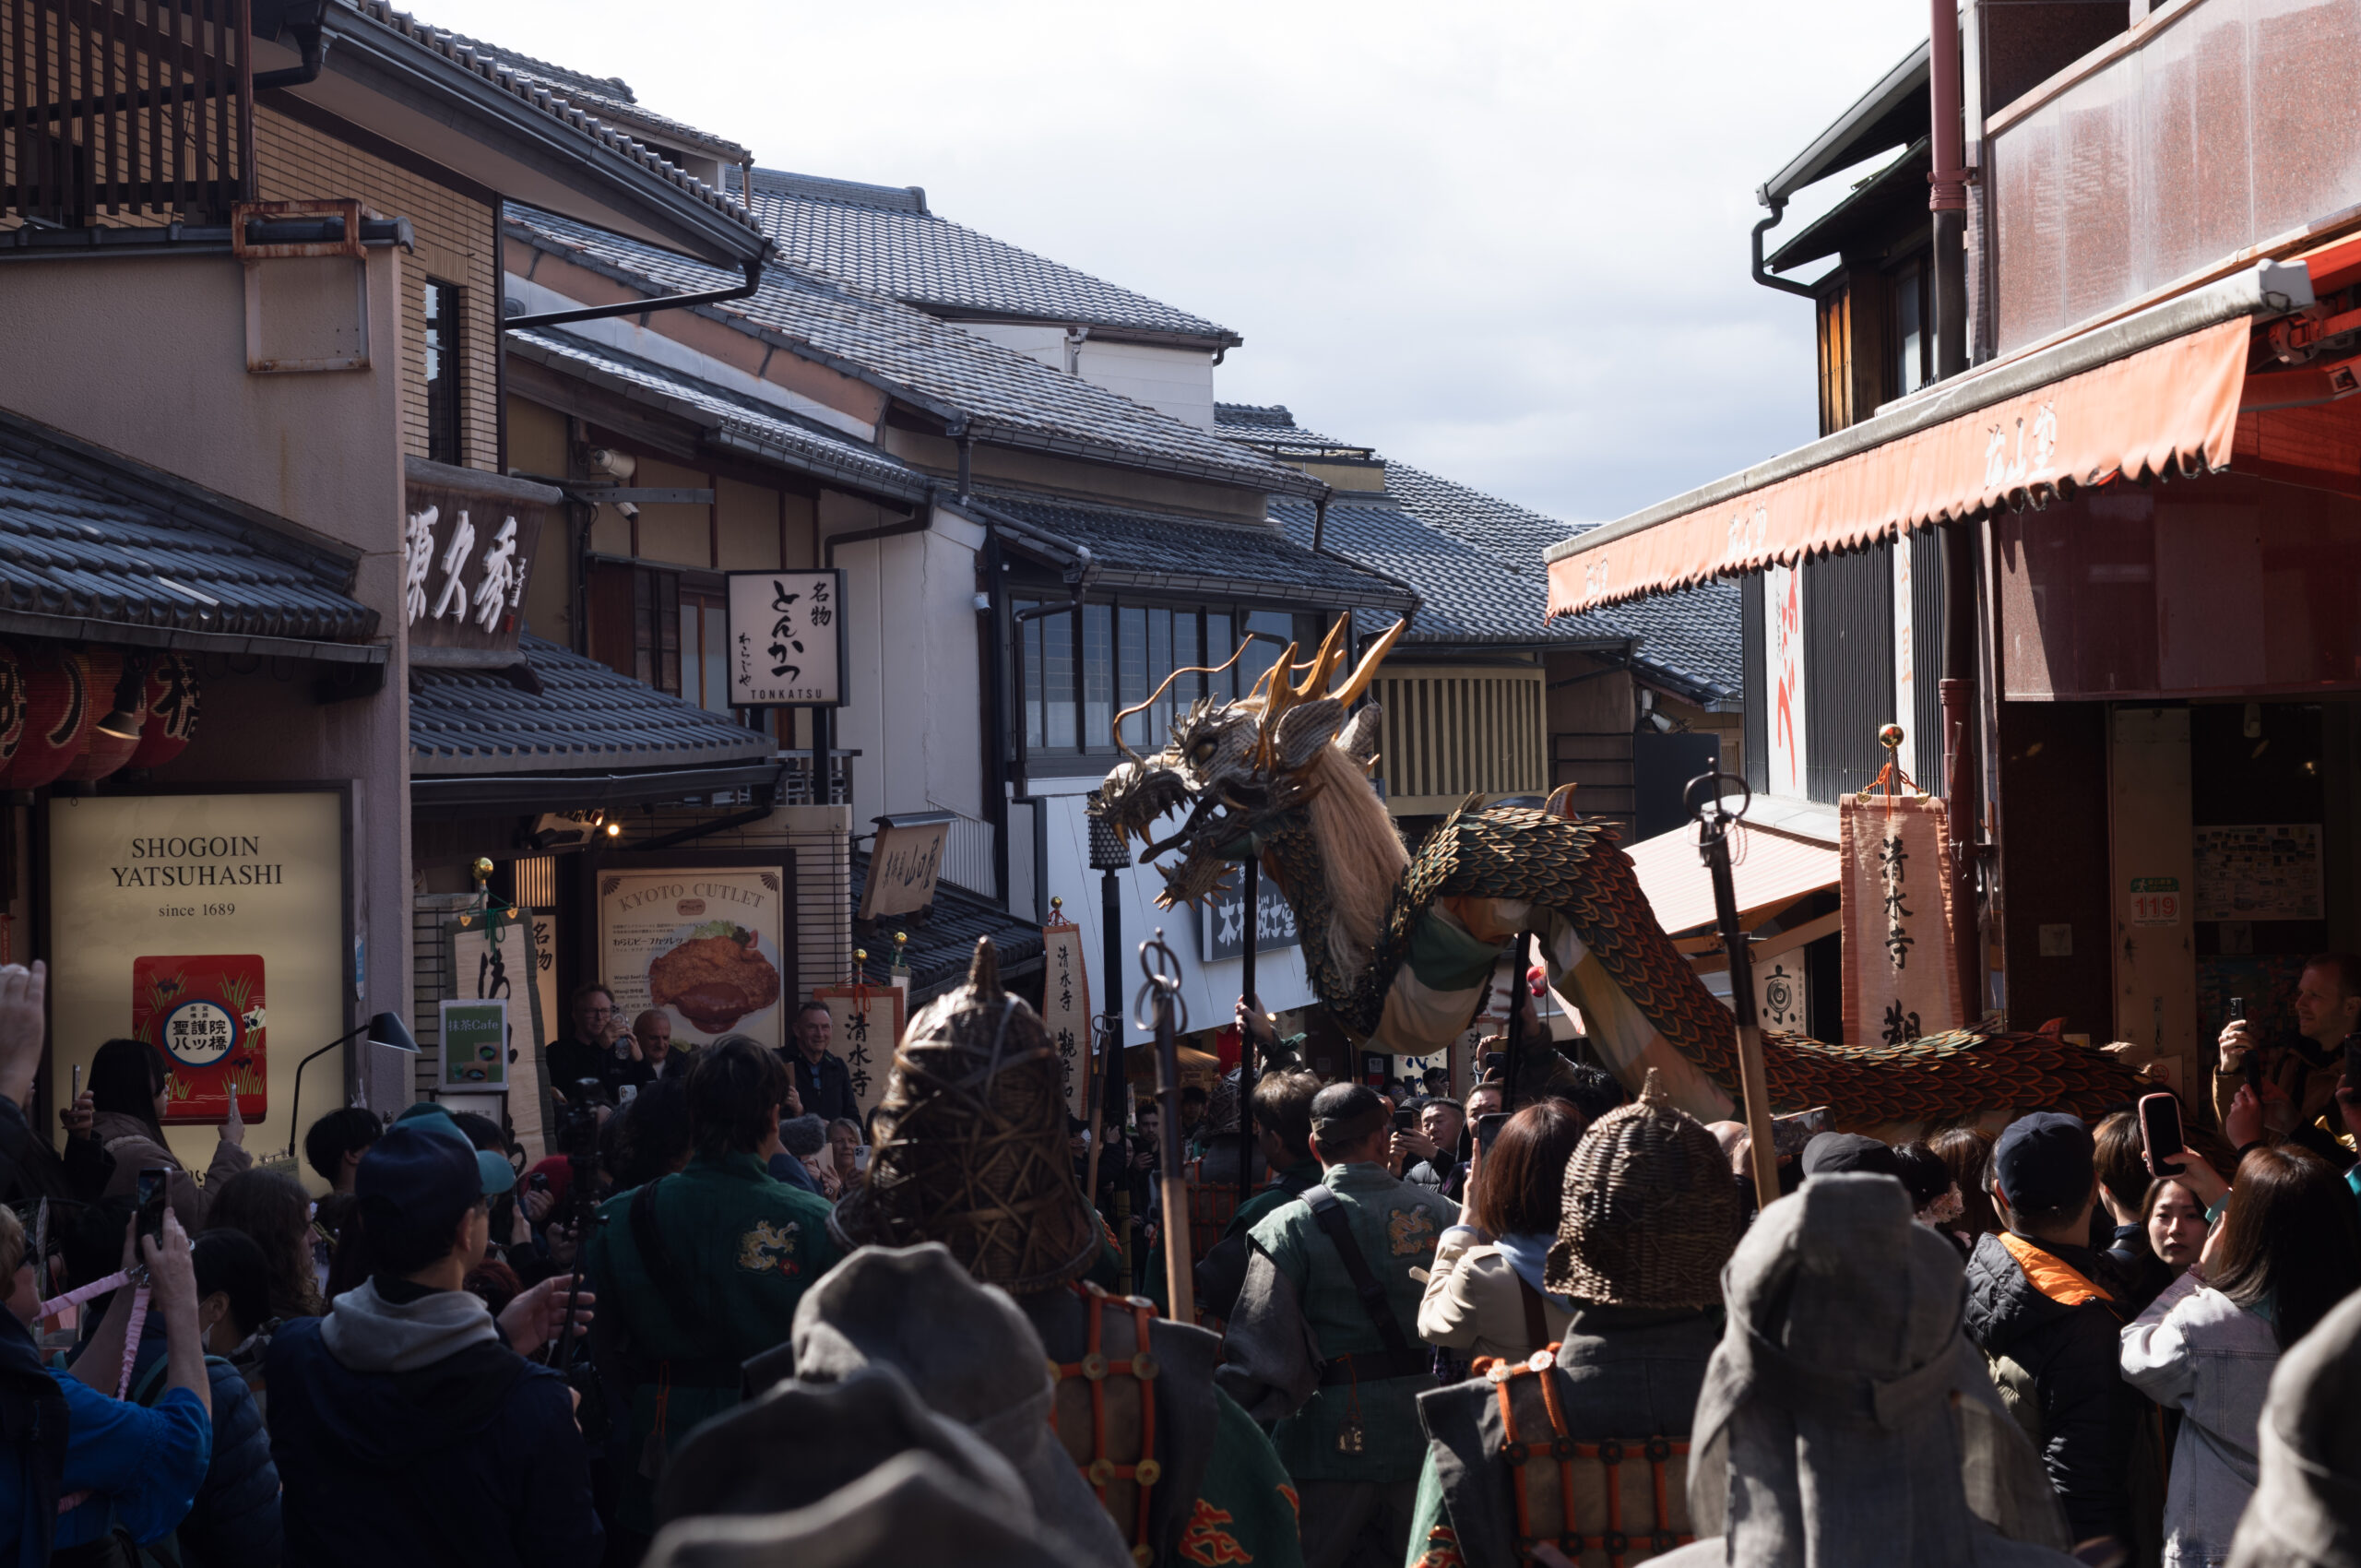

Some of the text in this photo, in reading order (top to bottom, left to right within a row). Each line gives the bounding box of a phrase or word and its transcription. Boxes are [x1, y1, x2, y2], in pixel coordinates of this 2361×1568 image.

[809, 581, 832, 626] 名物
[767, 579, 804, 684] とんかつ
[739, 632, 752, 686] わらじや
[751, 689, 822, 700] TONKATSU
[132, 837, 260, 859] SHOGOIN
[111, 863, 283, 887] YATSUHASHI
[159, 902, 235, 917] since 1689
[617, 882, 765, 912] KYOTO CUTLET
[1879, 836, 1915, 969] 清水寺
[2134, 897, 2176, 916] 119
[532, 921, 553, 971] 名物
[1057, 944, 1074, 1012] 清水寺
[172, 1020, 227, 1035] 聖護院
[447, 1018, 499, 1032] 抹茶Cafe
[844, 1012, 872, 1098] 清水寺
